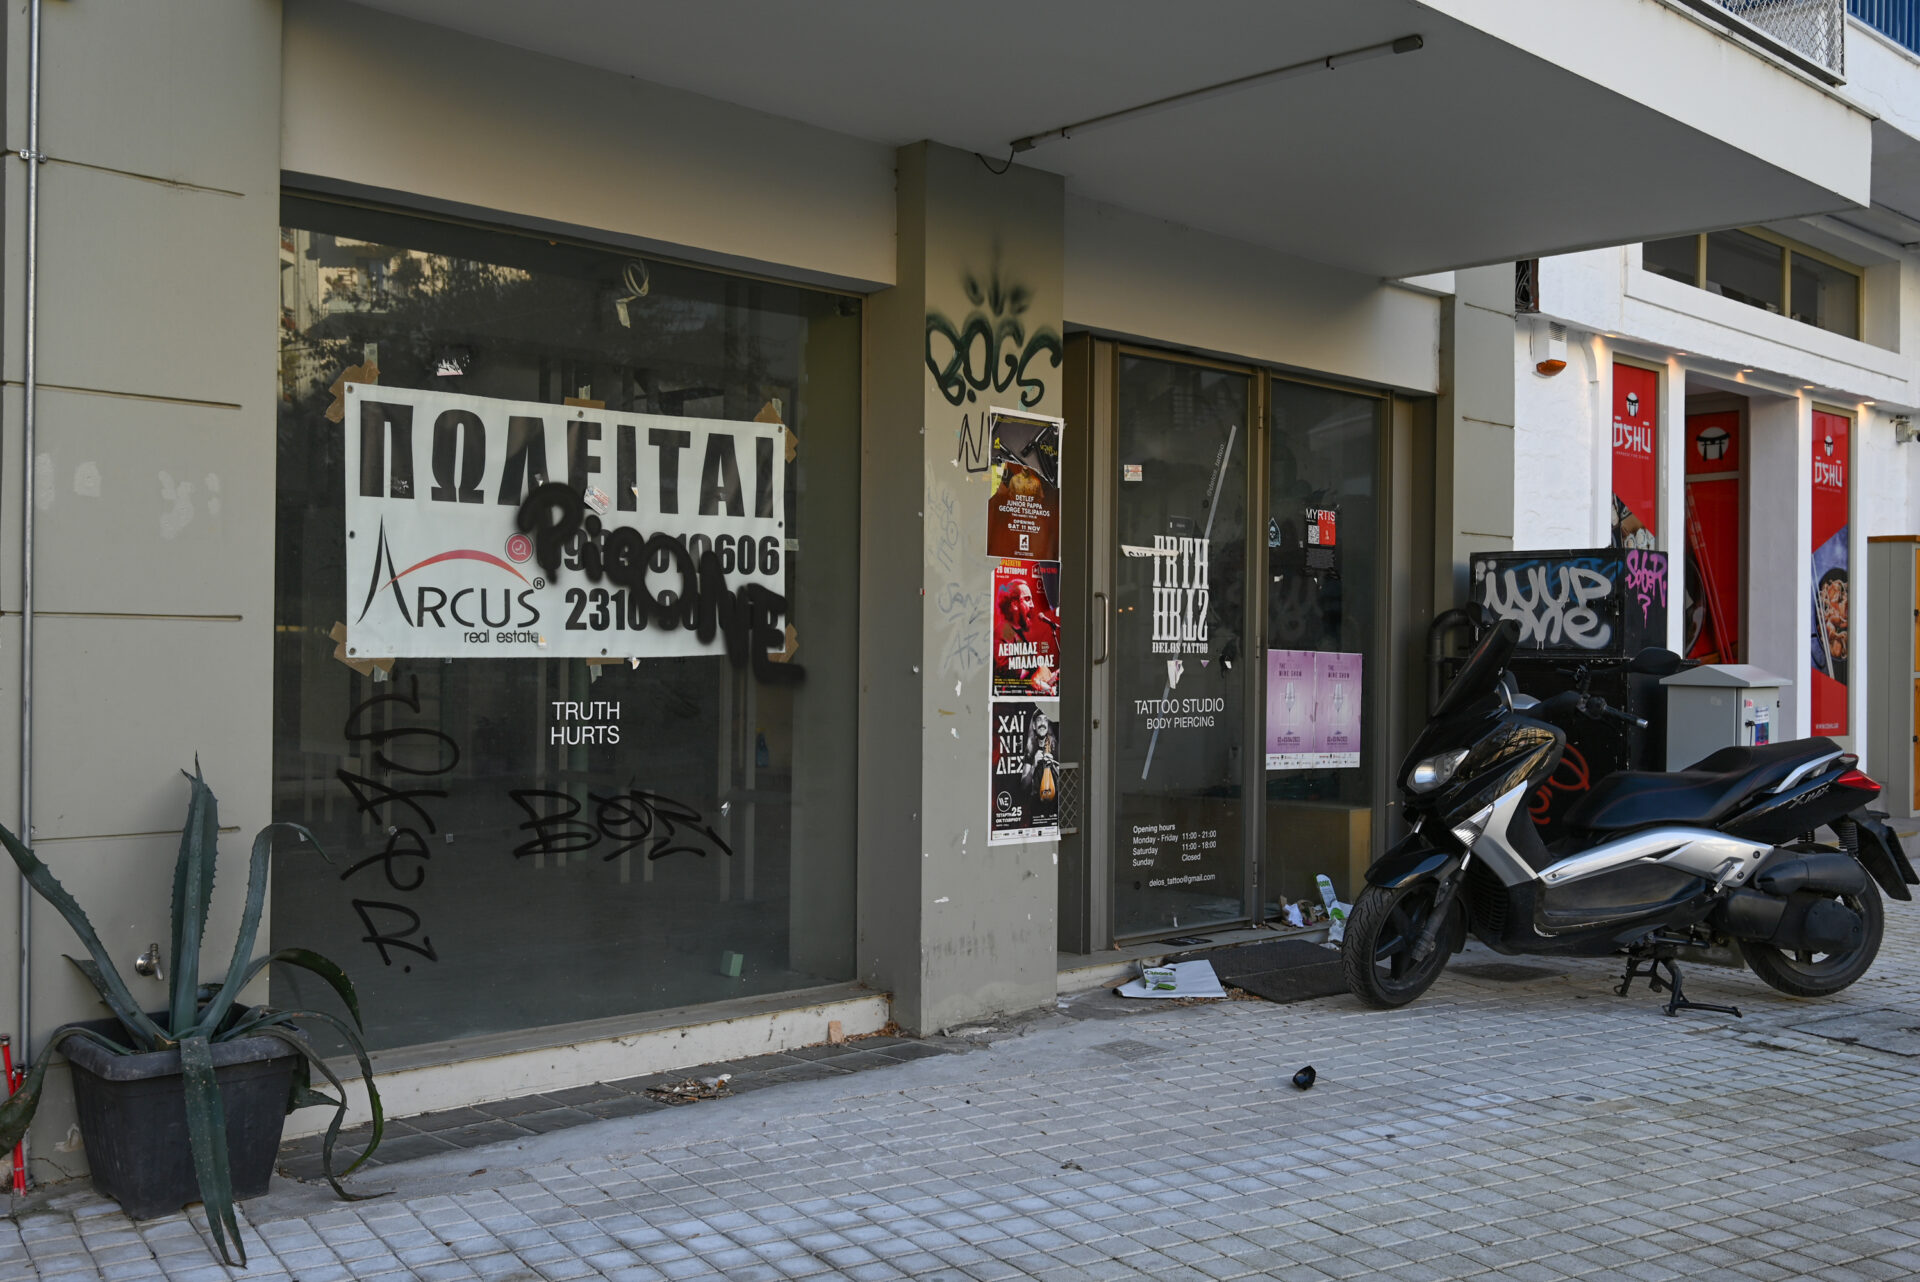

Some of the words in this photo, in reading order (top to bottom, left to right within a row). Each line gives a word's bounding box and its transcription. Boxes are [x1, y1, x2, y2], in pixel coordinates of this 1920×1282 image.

[359, 399, 775, 518] ΠΩΛΕΙΤΑΙ
[998, 505, 1021, 514] GEORGE
[1007, 500, 1026, 508] JUNIOR
[1027, 502, 1043, 510] PAPPA
[1305, 507, 1336, 522] MYRTIS
[355, 513, 541, 628] ARCUS
[463, 629, 490, 643] real
[496, 629, 539, 644] estate
[998, 641, 1038, 657] ΛΕΩΝΙΔΑΣ
[1151, 641, 1181, 654] DELOS
[1182, 642, 1209, 654] TATTOO
[1008, 654, 1055, 670] ΜΠΑΛΑΦΑΣ
[551, 701, 620, 721] TRUTH
[1134, 698, 1180, 715] TATTOO
[1182, 697, 1225, 714] STUDIO
[997, 710, 1027, 734] ΧΑΪ
[1146, 717, 1172, 730] BODY
[1173, 715, 1215, 729] PIERCING
[551, 725, 620, 745] HURTS
[999, 734, 1024, 754] ΝΗ
[996, 755, 1025, 775] ΔΕΣ
[1011, 806, 1023, 817] 25
[1132, 825, 1158, 835] Opening
[1158, 823, 1176, 832] hours
[1132, 836, 1157, 845] Monday
[1160, 834, 1179, 843] Friday
[1182, 831, 1198, 841] 11:00
[1201, 830, 1217, 839] 21:00
[1132, 846, 1159, 856] Saturday
[1182, 842, 1198, 851] 11:00
[1201, 840, 1217, 849] 18:00
[1132, 858, 1155, 867] Sunday
[1181, 852, 1202, 862] Closed
[1148, 873, 1216, 887] delos_tattoo@gmail.com
